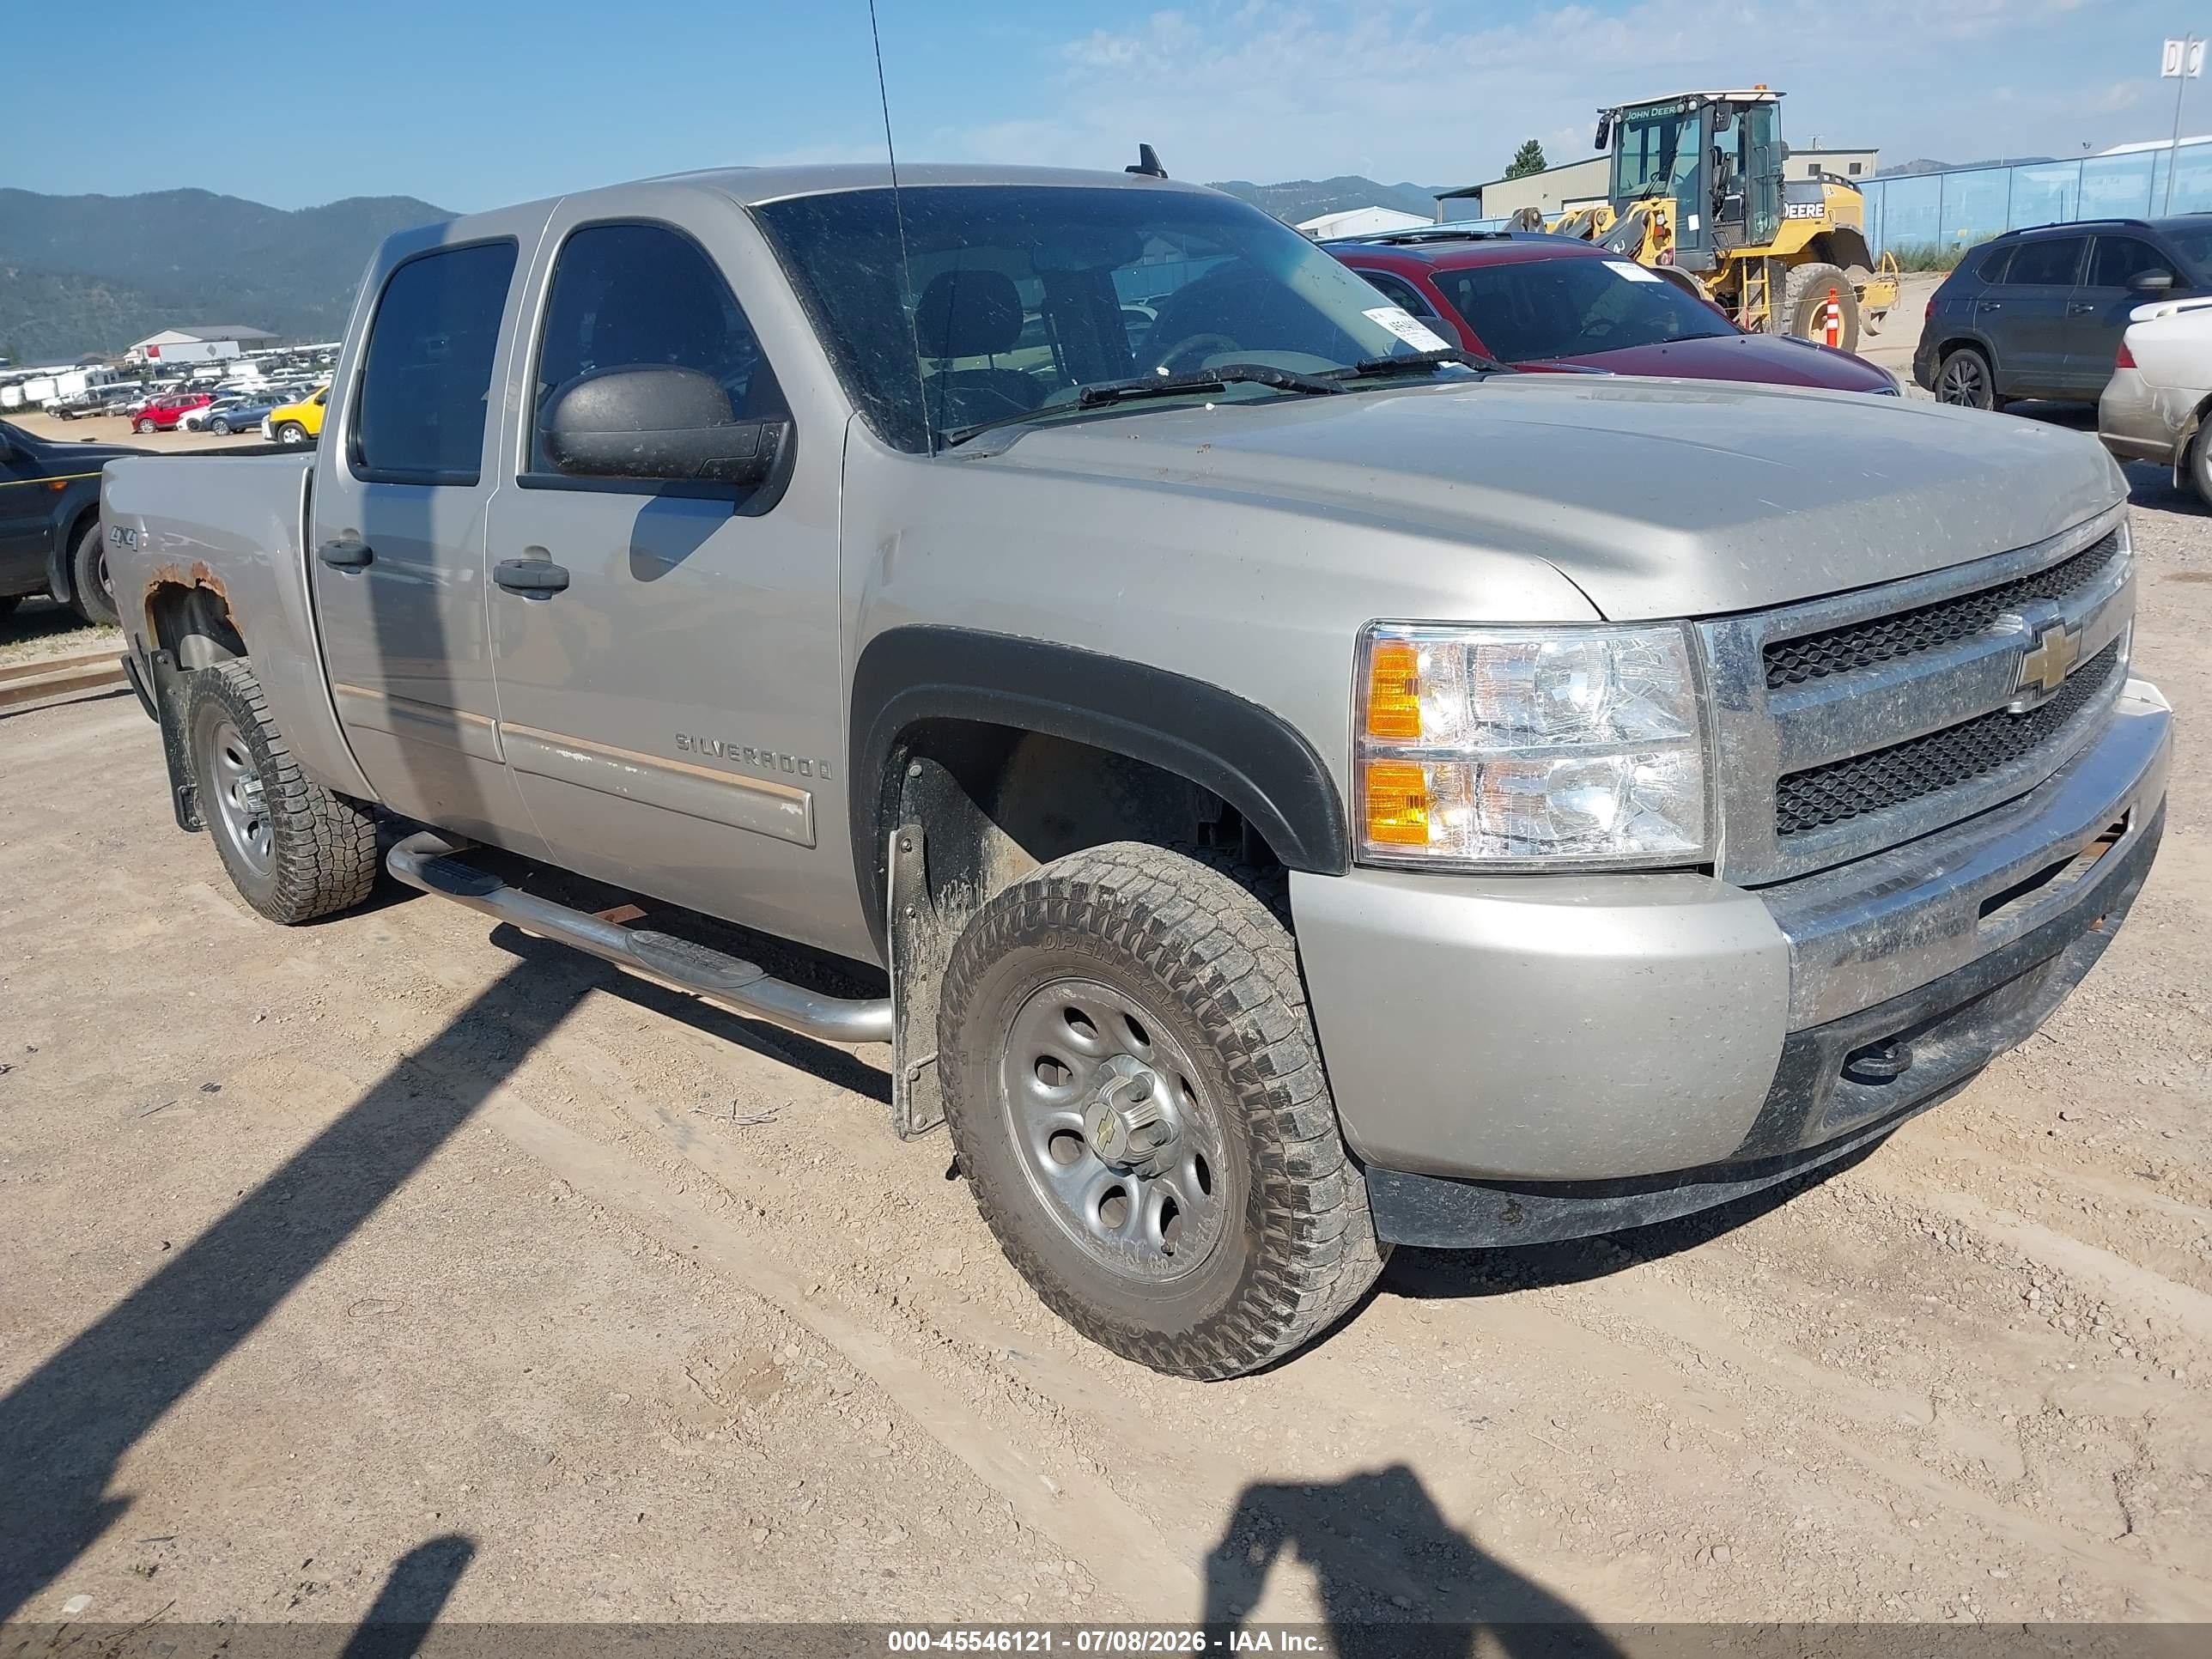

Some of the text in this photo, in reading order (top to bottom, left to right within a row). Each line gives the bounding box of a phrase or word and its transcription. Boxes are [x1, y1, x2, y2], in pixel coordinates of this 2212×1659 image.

[2166, 44, 2199, 74] D C
[1625, 105, 1677, 121] JOHN DEER
[675, 732, 814, 777] SILVERADO
[1041, 929, 1121, 965] OPEN
